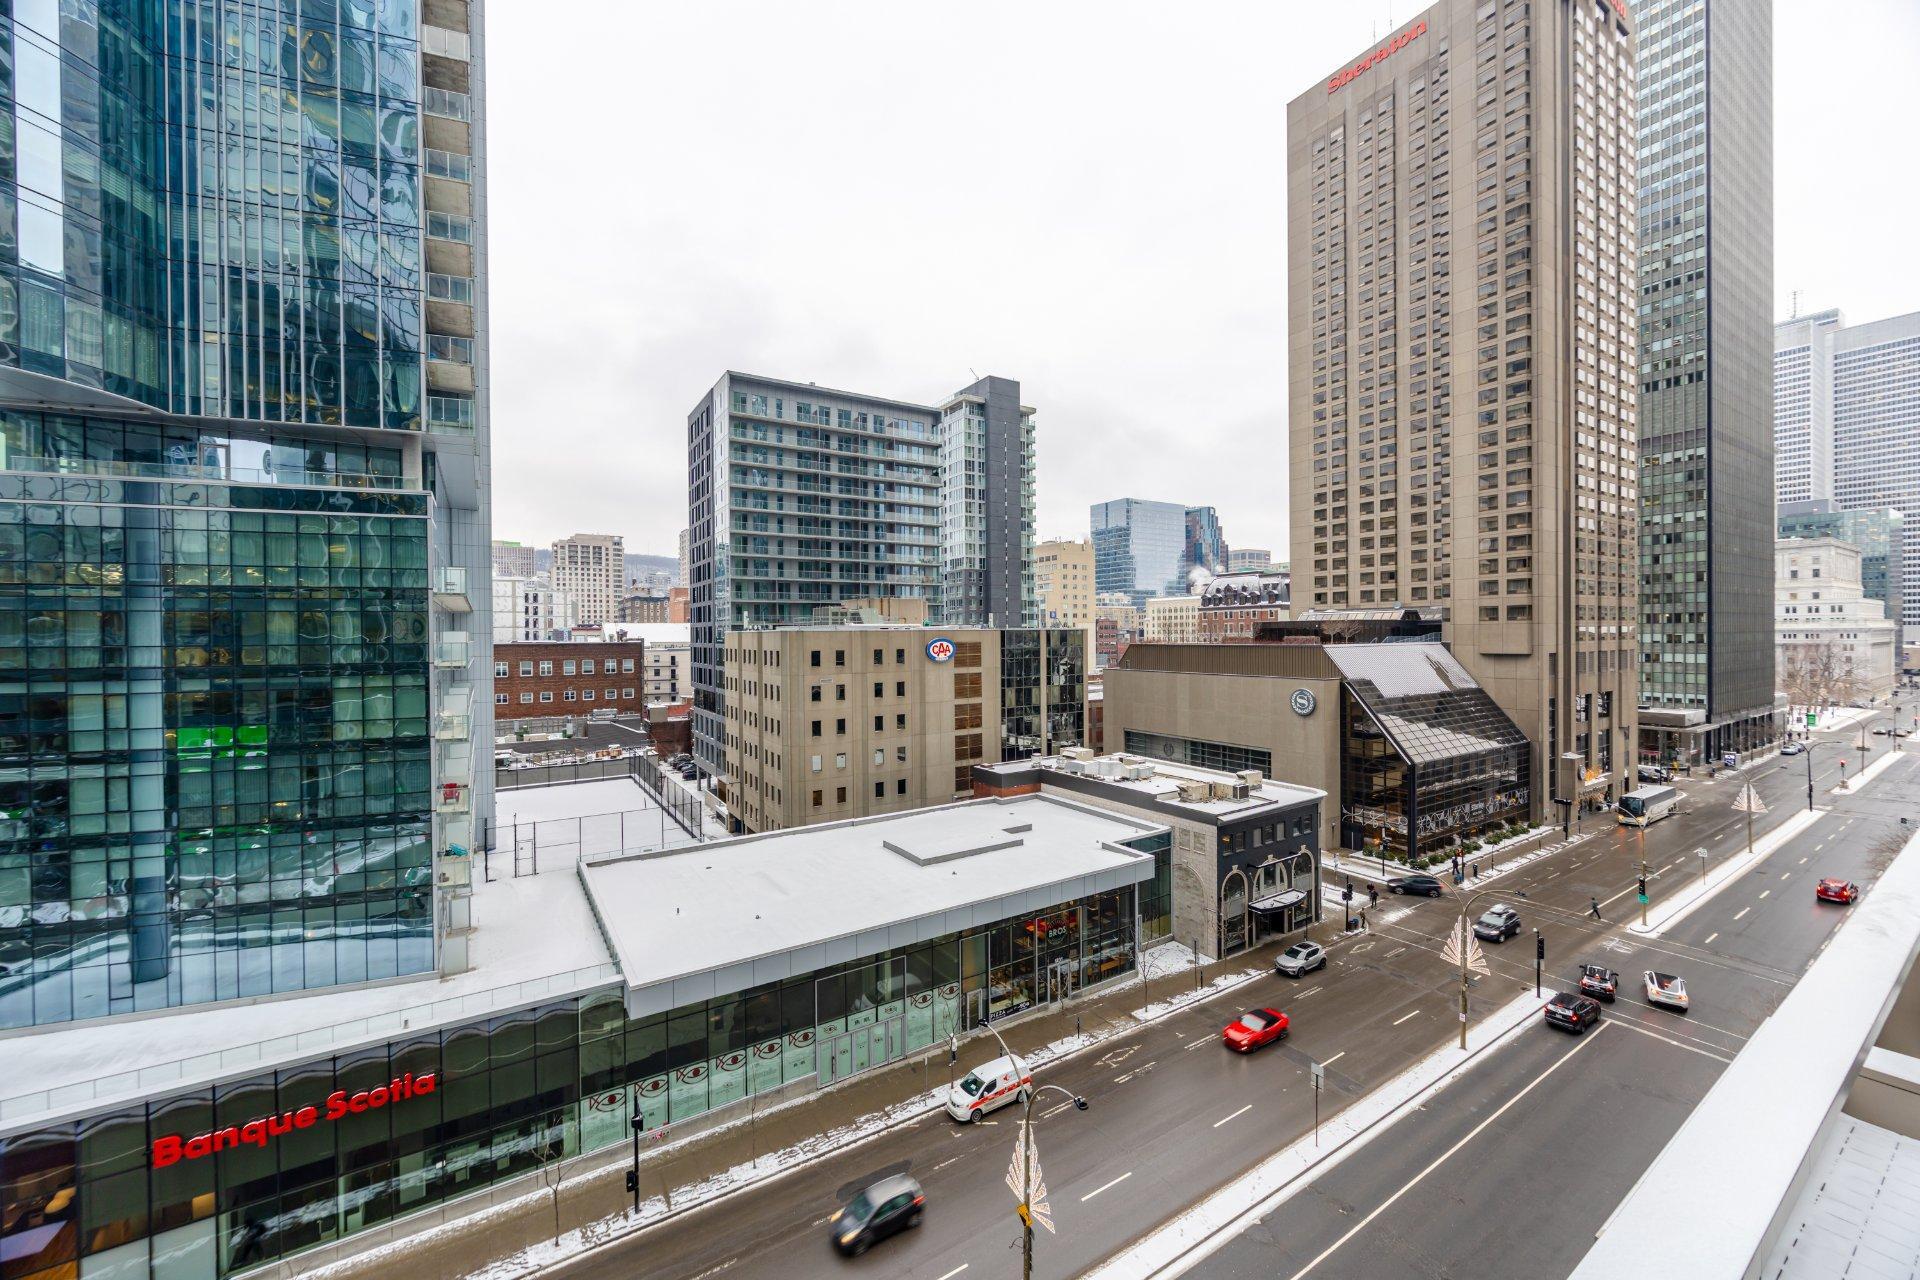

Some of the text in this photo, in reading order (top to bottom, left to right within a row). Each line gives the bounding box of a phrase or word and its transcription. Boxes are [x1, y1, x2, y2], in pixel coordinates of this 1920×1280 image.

[1327, 21, 1427, 94] Sheraton
[932, 643, 950, 656] CAA
[1048, 925, 1067, 938] BROS
[990, 1009, 1007, 1019] PIZZA
[152, 1072, 437, 1169] Banque Scotia
